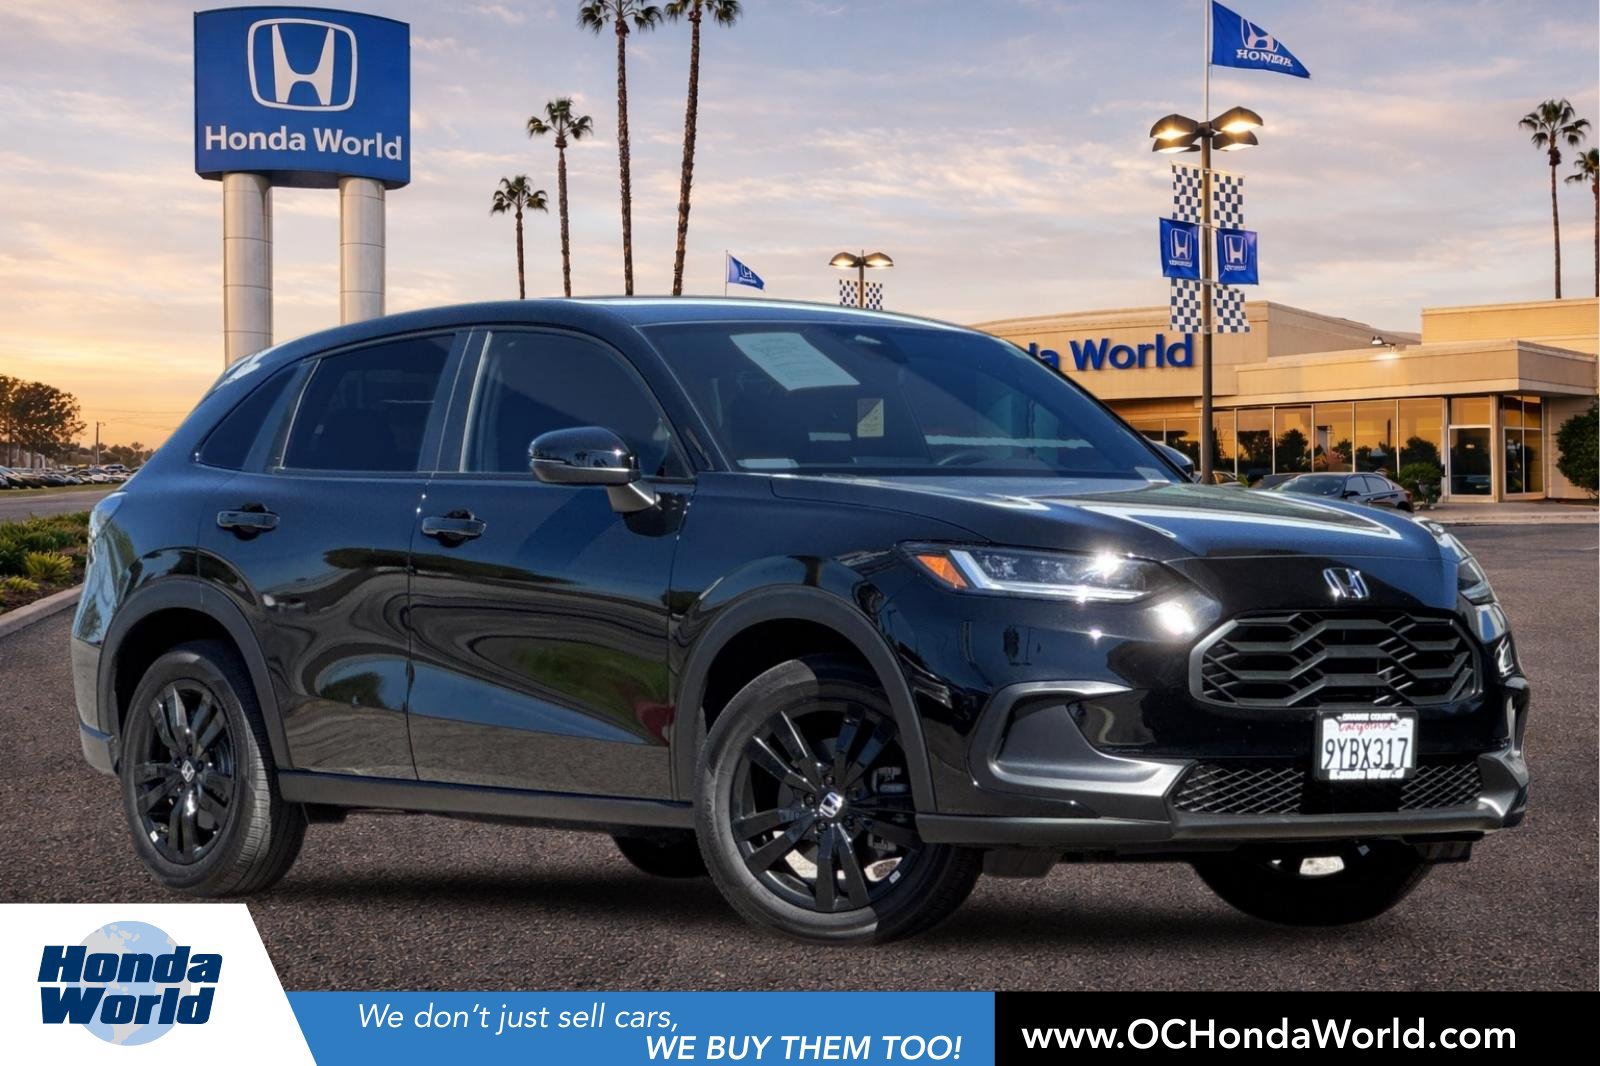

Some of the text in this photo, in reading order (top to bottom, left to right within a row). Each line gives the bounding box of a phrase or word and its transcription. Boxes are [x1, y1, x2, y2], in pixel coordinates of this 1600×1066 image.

[205, 125, 402, 160] Honda World
[1069, 333, 1195, 371] World
[1324, 738, 1408, 769] 9YBX317
